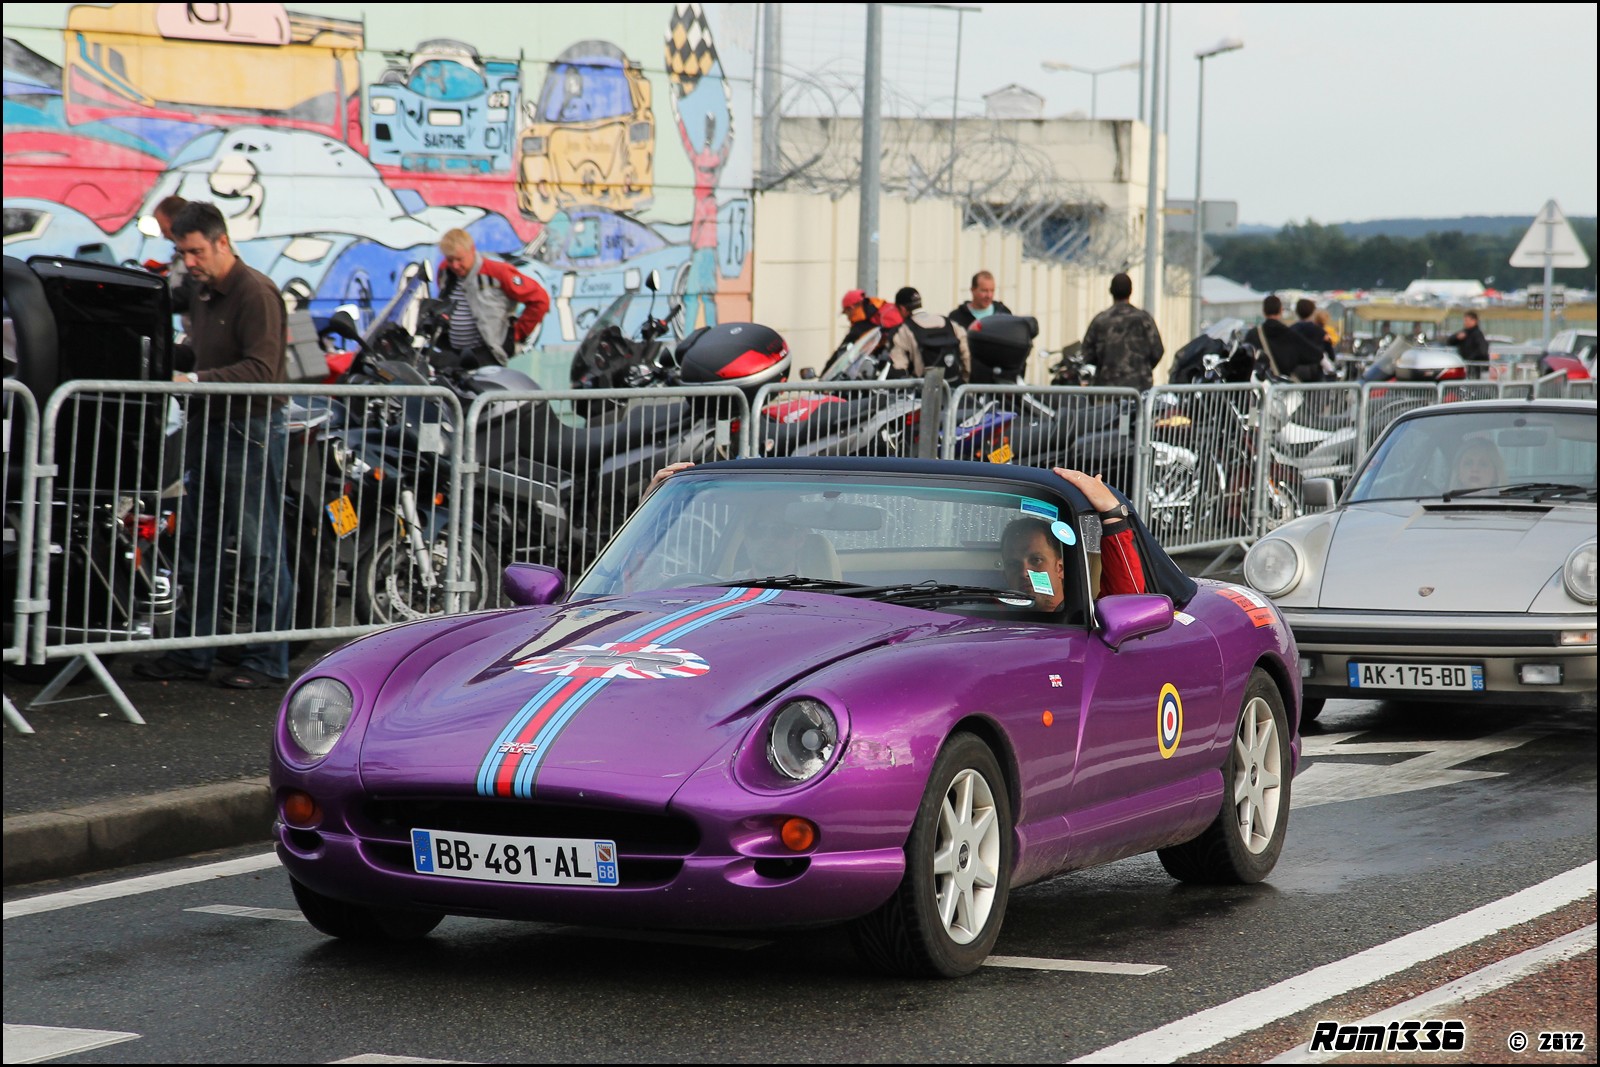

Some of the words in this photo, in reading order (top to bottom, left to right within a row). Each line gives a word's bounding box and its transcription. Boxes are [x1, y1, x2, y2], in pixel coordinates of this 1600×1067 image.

[424, 133, 466, 149] SARTHE
[727, 207, 746, 266] 13
[1363, 665, 1466, 687] AK-175-BD
[1473, 680, 1484, 689] 35
[419, 855, 427, 865] F
[435, 838, 592, 878] BB-481-AL
[599, 865, 615, 879] 68
